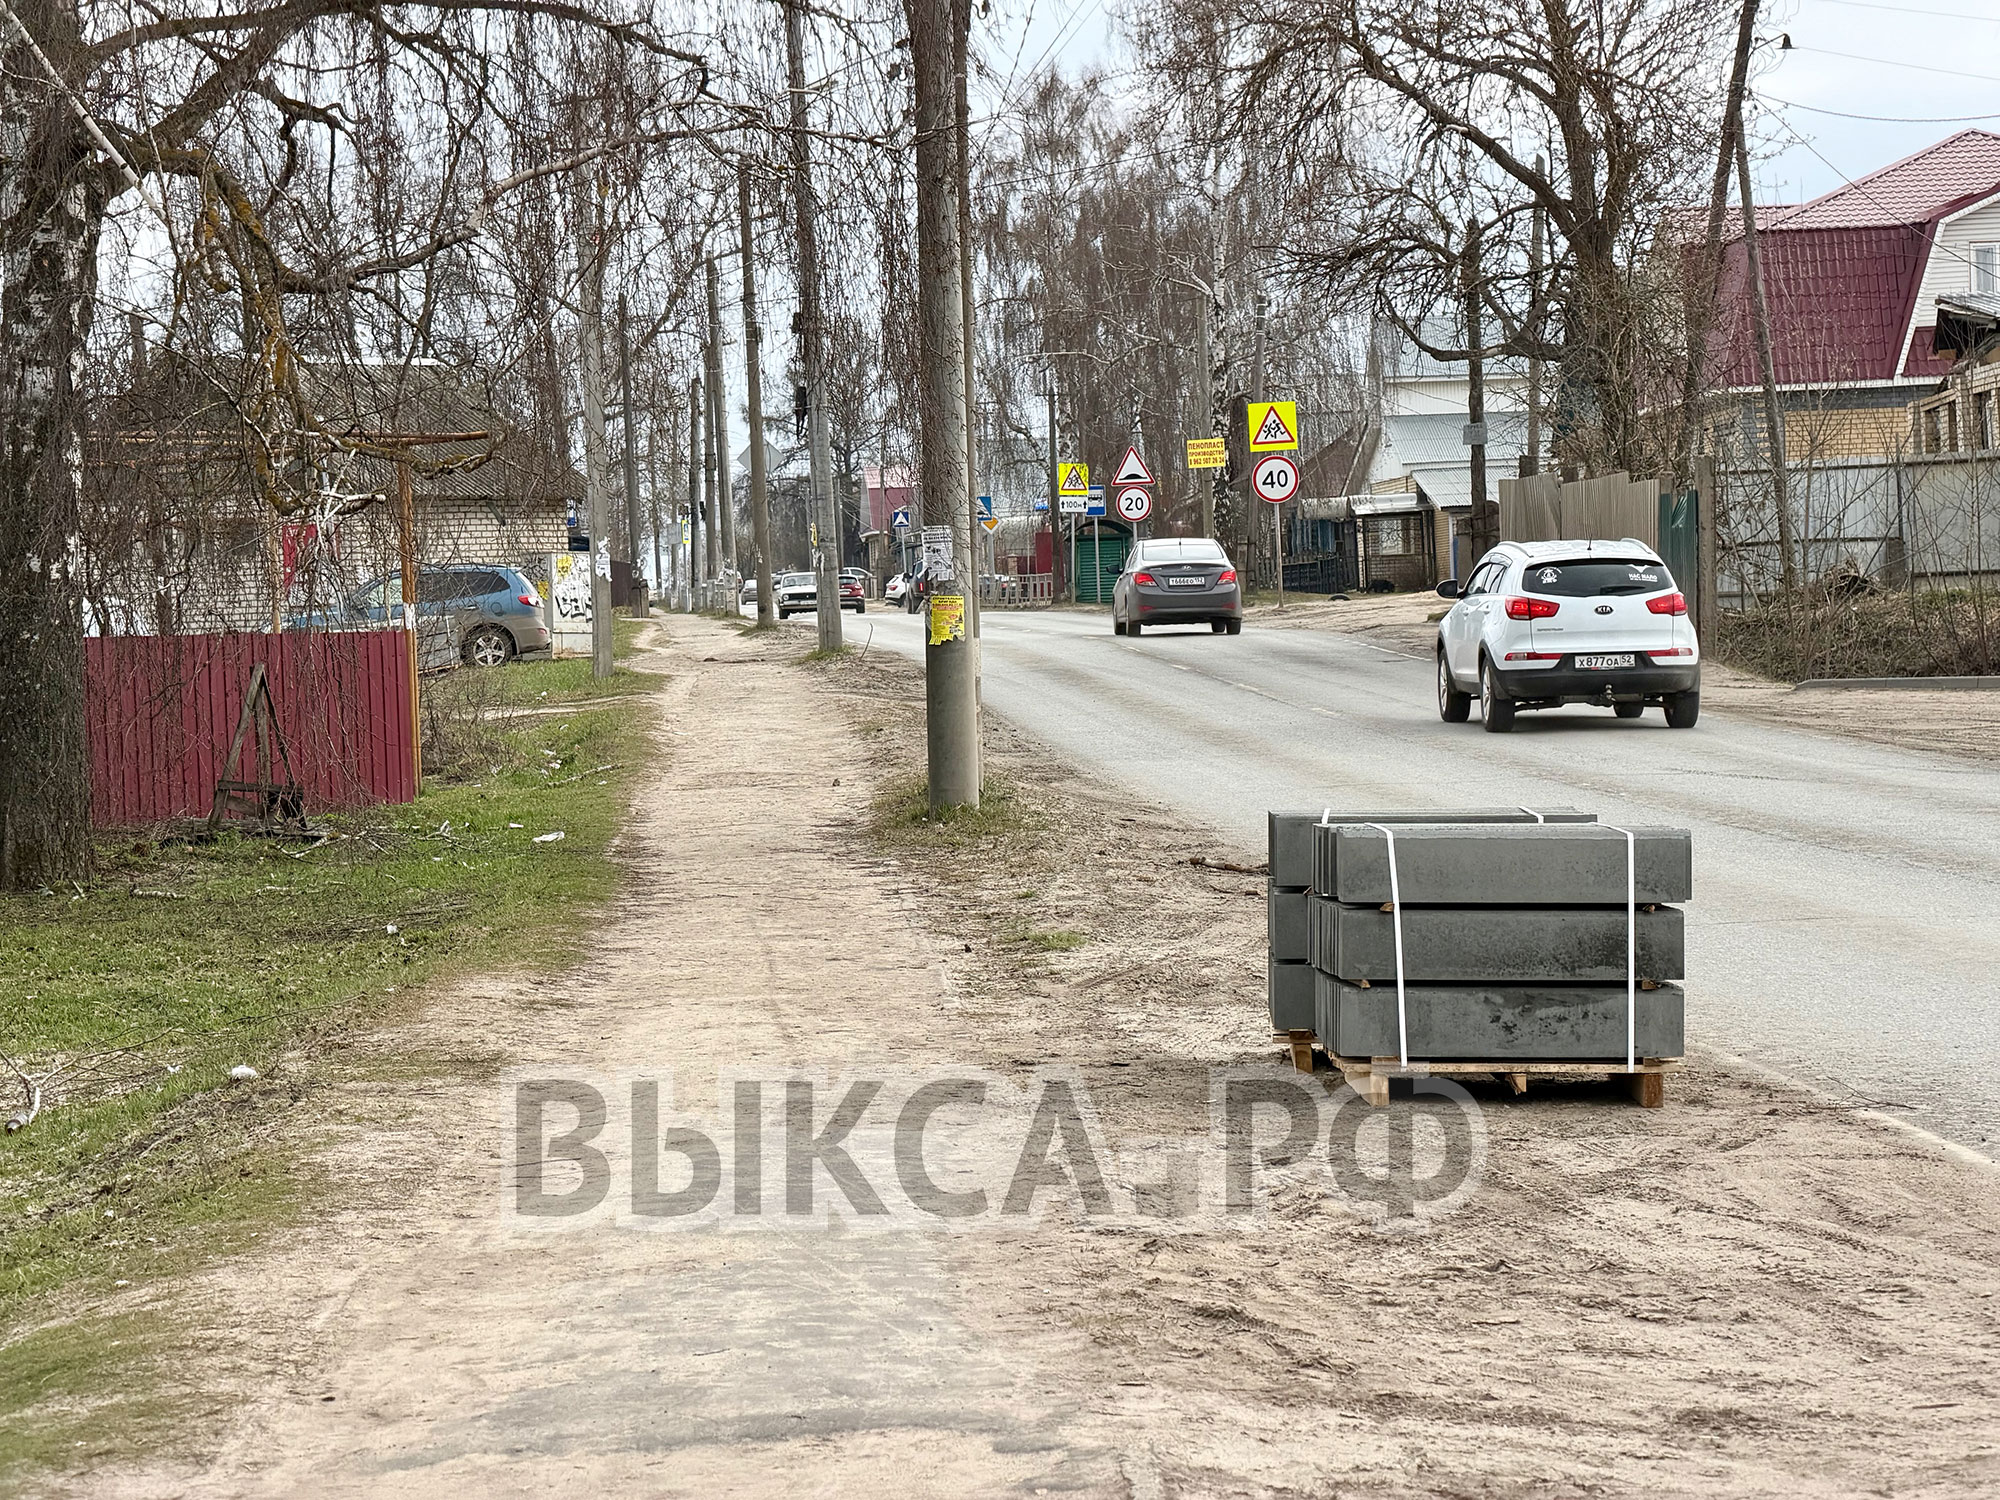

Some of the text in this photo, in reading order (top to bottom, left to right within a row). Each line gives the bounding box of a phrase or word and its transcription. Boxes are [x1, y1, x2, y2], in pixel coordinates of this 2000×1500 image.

[1188, 441, 1224, 450] ПЕНОПЛАСТ
[1262, 470, 1288, 488] 40
[1125, 497, 1144, 511] 20
[1579, 655, 1632, 667] Х877ОА 52
